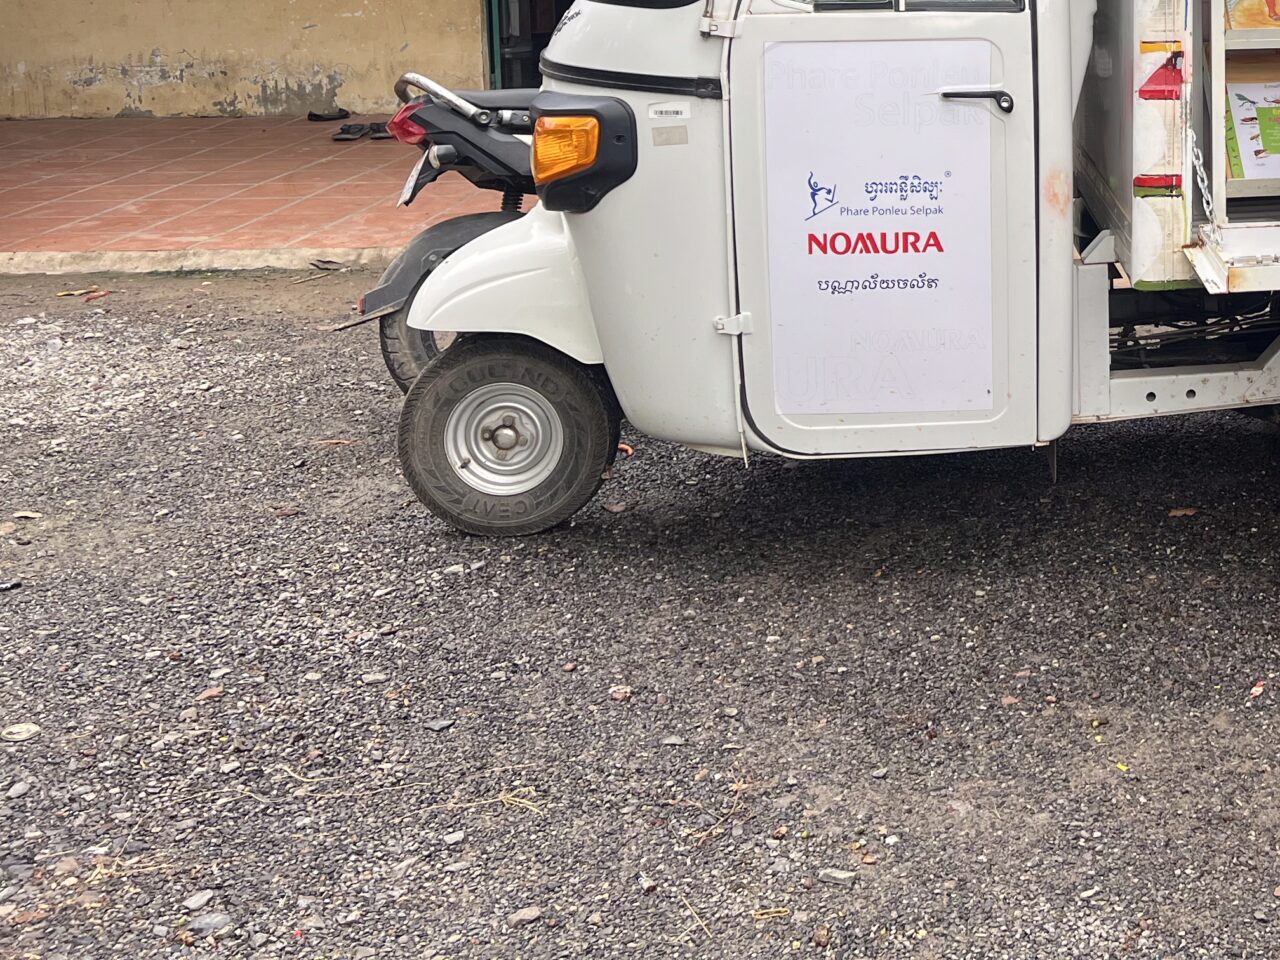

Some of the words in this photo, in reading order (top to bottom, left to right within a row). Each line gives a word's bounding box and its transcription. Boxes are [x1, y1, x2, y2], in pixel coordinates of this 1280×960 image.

[839, 205, 869, 217] Phare
[871, 205, 908, 217] Ponleu
[909, 205, 944, 219] Selpak
[807, 231, 944, 256] NOMURA
[817, 272, 940, 296] បណ្ណាល័យចល័ត
[459, 497, 527, 519] CEAT
